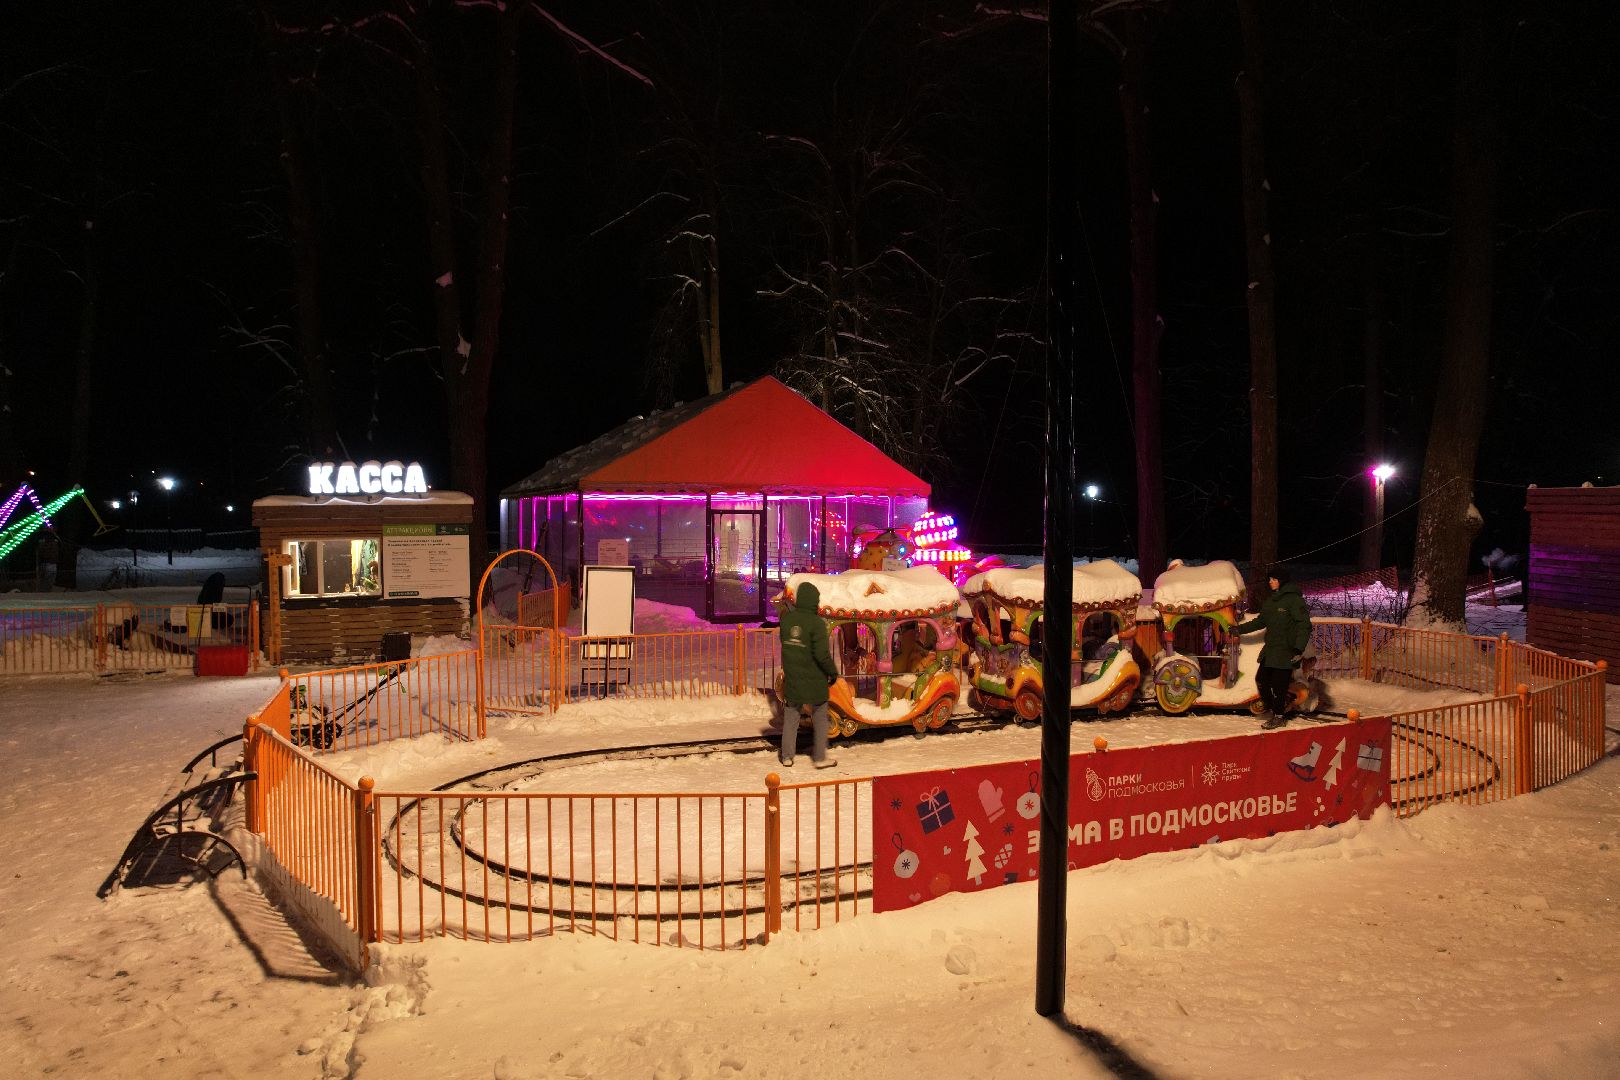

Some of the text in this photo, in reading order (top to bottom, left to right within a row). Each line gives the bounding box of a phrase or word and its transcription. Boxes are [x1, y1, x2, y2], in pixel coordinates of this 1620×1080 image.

[308, 464, 428, 494] КАССА
[1108, 773, 1142, 786] ПАРКИ
[1108, 779, 1185, 798] ПОДМОСКОВЬЯ
[1027, 792, 1298, 854] ЗМА В ПОДМОСКОВЬЕ
